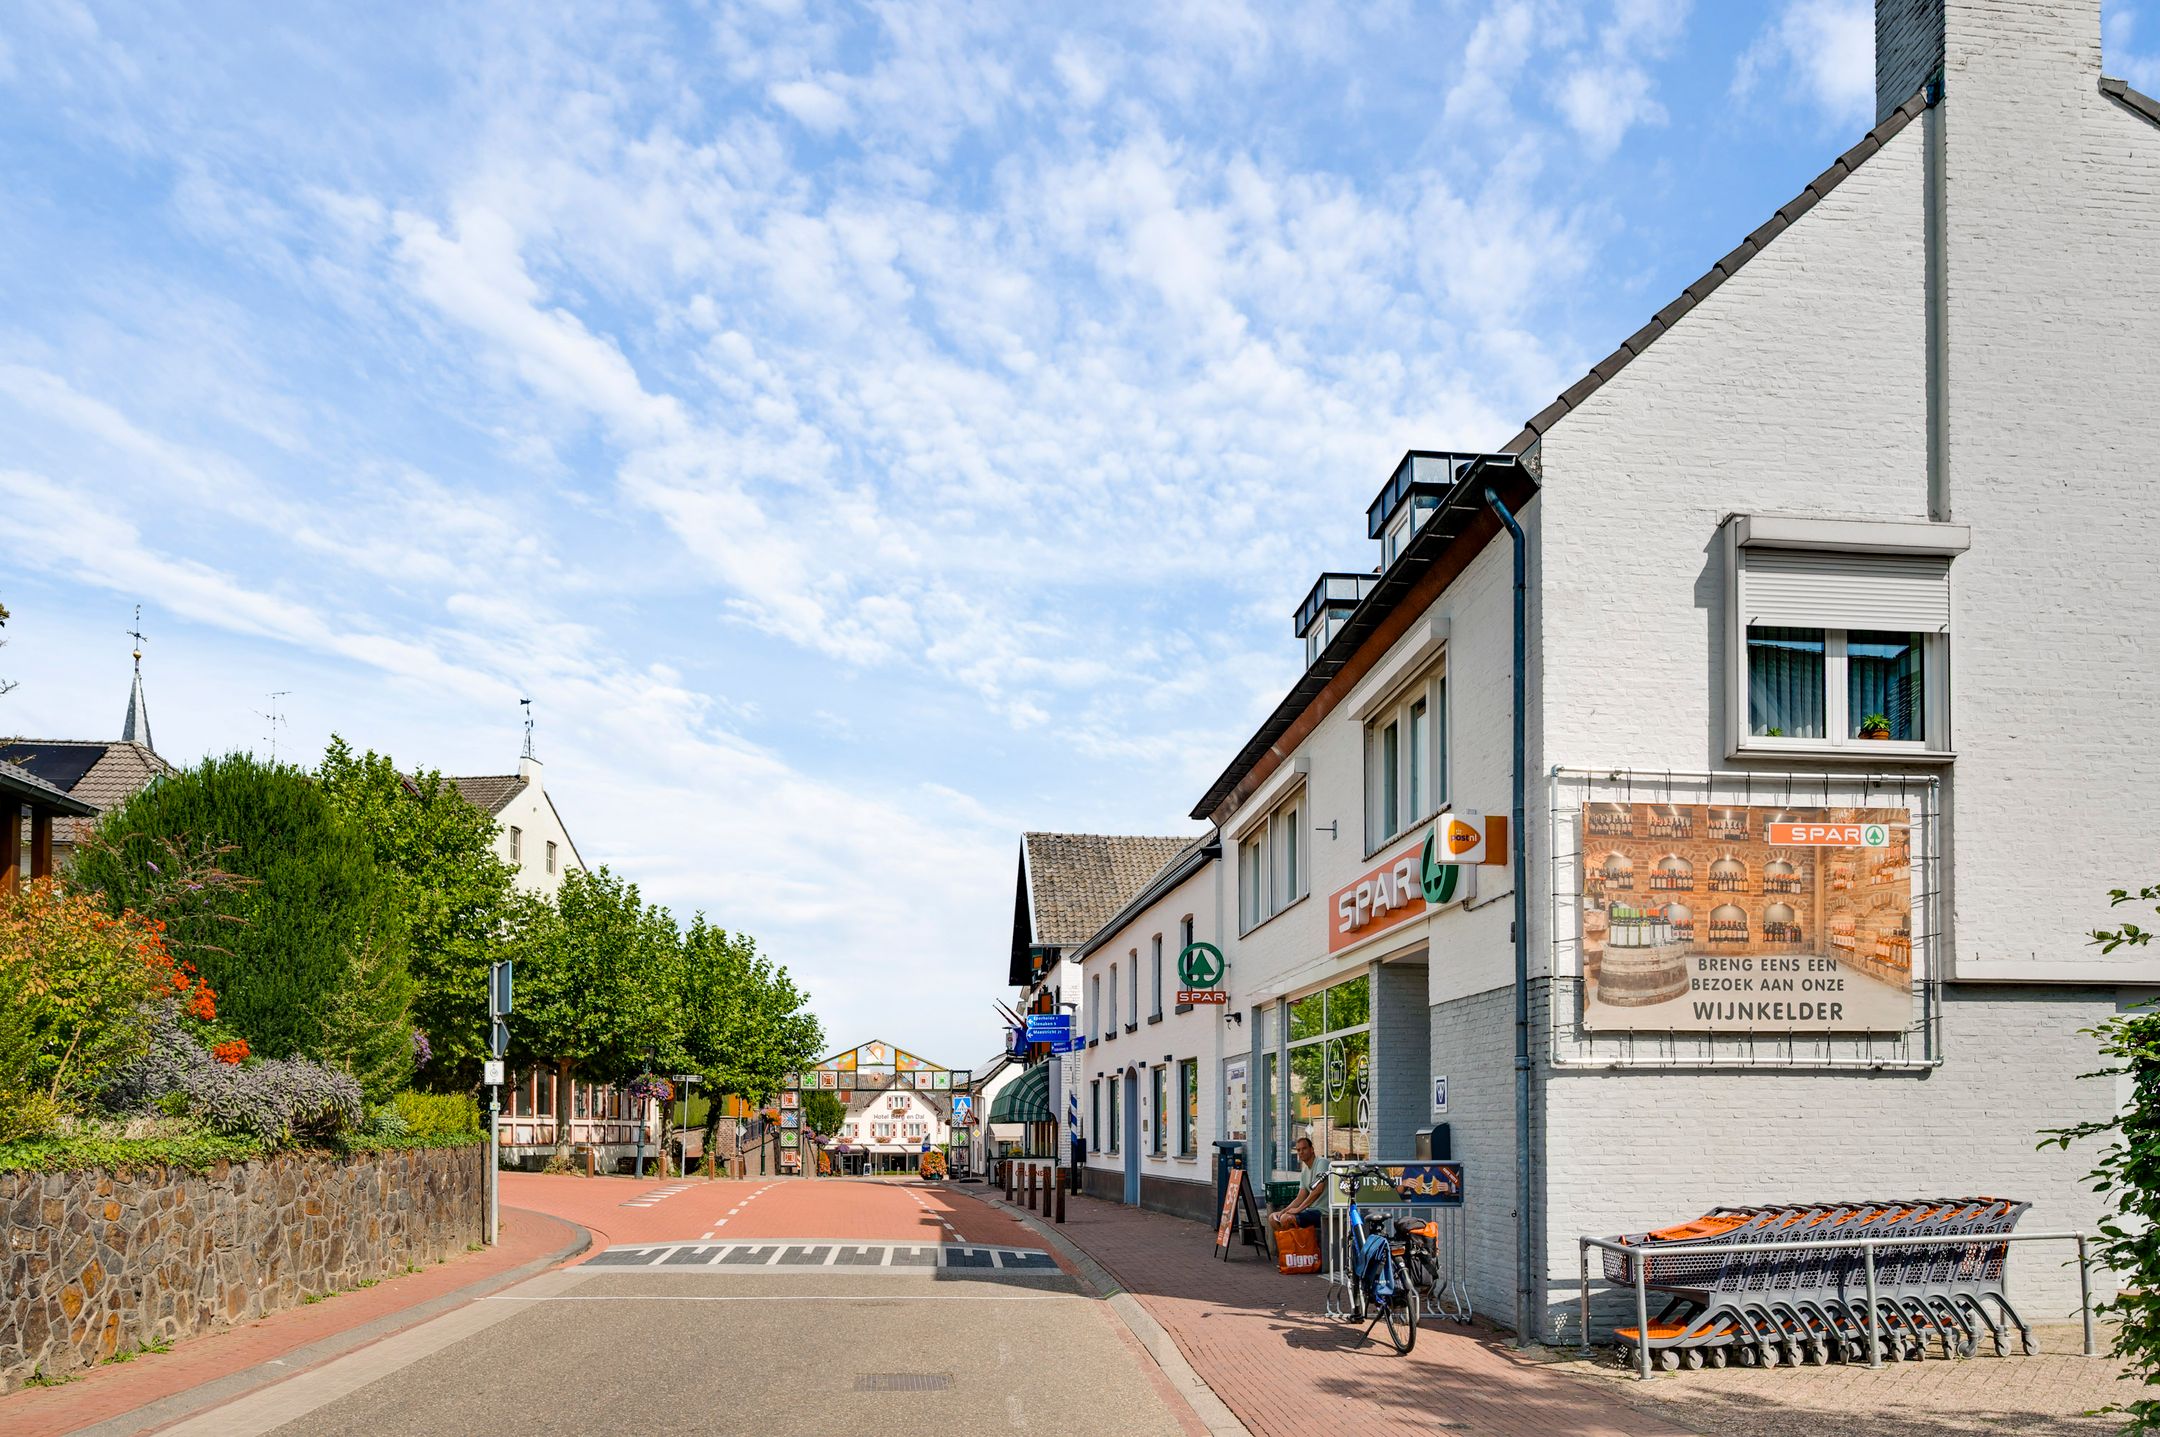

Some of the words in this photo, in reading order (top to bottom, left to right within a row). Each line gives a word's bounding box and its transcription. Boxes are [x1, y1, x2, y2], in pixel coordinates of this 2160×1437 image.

[1791, 826, 1860, 842] SPAR
[1338, 857, 1412, 934] SPAR
[1698, 957, 1753, 972] BRENG
[1760, 957, 1800, 972] EENS
[1808, 957, 1837, 972] EEN
[1691, 977, 1754, 992] BEZOEK
[1760, 977, 1795, 992] AAN
[1801, 978, 1845, 992] ONZE
[1179, 992, 1224, 1002] SPAR
[1693, 1001, 1844, 1021] WIJNKELDER
[1362, 1176, 1378, 1186] IT'S
